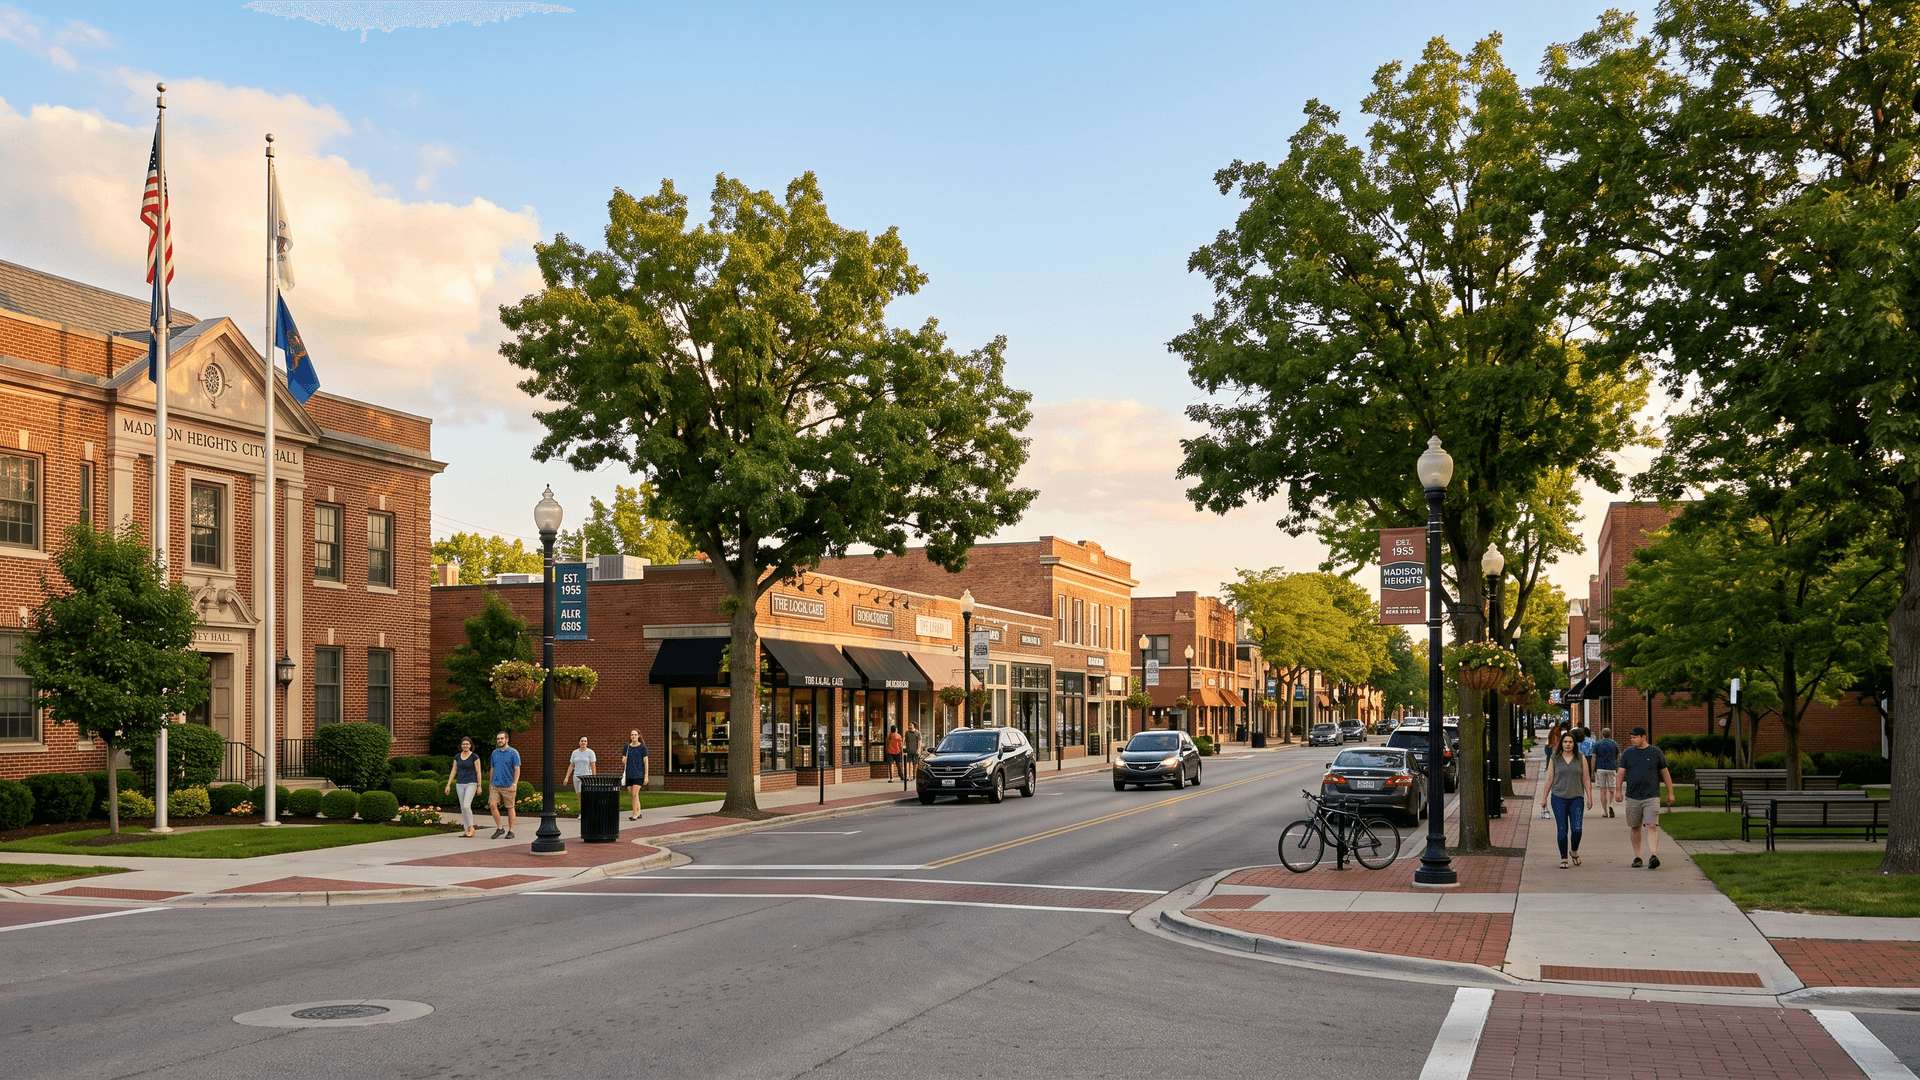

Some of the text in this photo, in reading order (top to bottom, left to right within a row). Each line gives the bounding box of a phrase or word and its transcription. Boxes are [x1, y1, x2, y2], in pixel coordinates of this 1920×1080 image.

[123, 418, 182, 442] MADION
[187, 431, 238, 453] HEIGHTS
[242, 442, 267, 459] CITY
[1383, 567, 1422, 576] MADISON
[563, 573, 580, 583] EST.
[1384, 576, 1422, 585] HEIGHTS
[561, 585, 582, 595] 1955
[774, 597, 788, 611] THE
